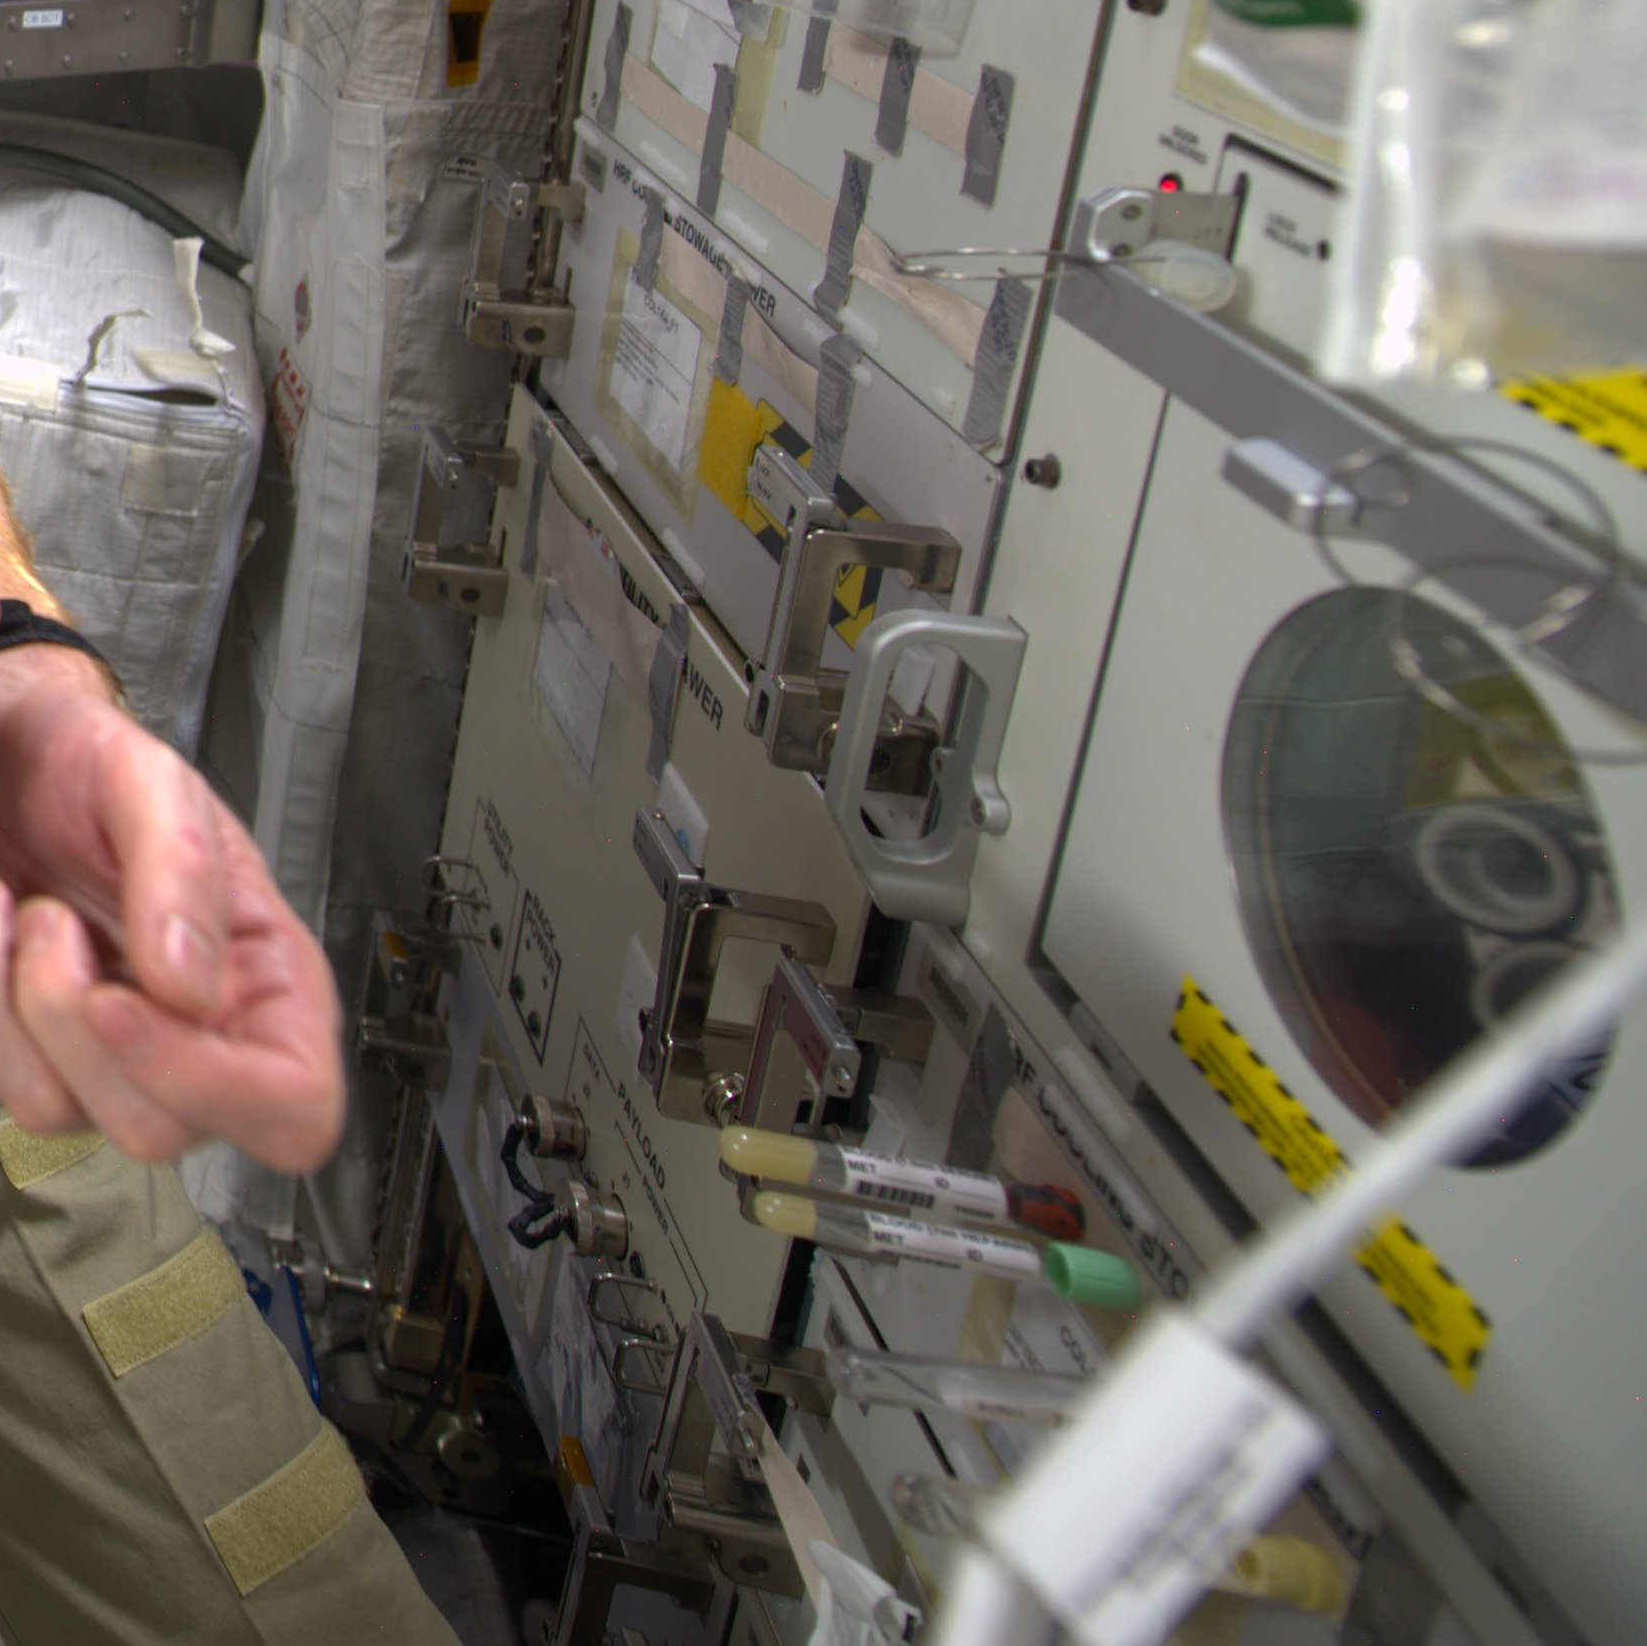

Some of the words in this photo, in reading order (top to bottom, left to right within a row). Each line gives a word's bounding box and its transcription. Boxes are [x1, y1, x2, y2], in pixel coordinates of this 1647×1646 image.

[613, 159, 632, 185] HRF
[525, 895, 559, 943] RACK
[524, 911, 560, 974] POWER
[582, 1043, 602, 1082] DATA
[618, 1084, 666, 1189] PAYLOAD
[848, 1160, 877, 1175] MET
[935, 1177, 950, 1190] ID
[641, 1176, 668, 1233] POWER
[874, 1231, 904, 1246] MET
[967, 1249, 983, 1262] ID
